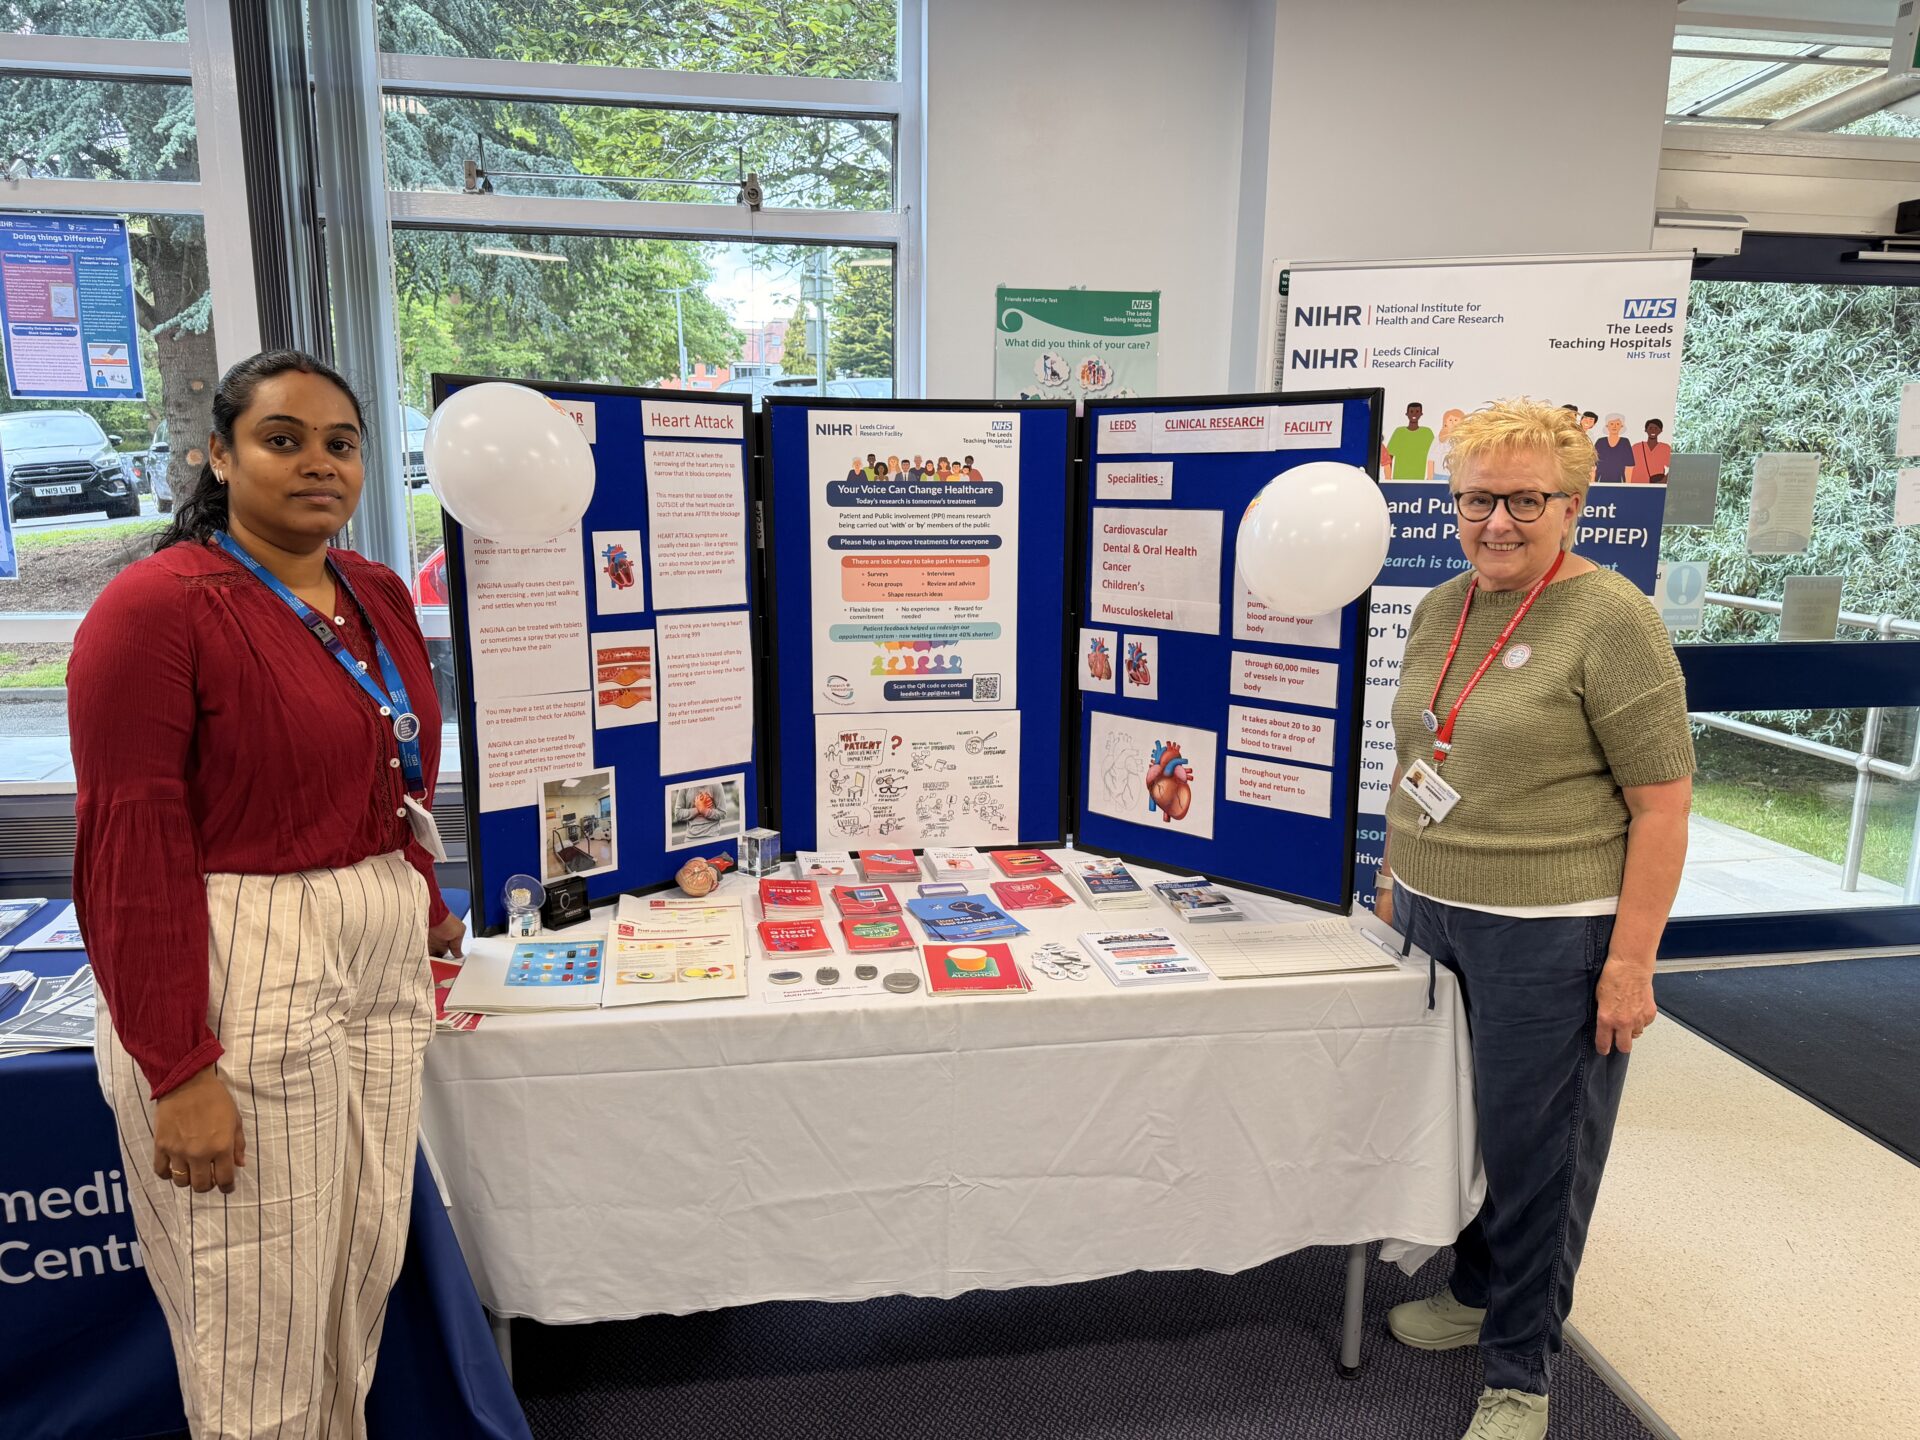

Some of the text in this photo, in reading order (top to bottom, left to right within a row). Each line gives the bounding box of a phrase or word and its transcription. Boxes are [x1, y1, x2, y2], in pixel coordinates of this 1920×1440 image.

[13, 233, 106, 244] Doing things Differently
[1132, 301, 1151, 309] NHS
[1376, 302, 1481, 313] National Institute for
[1626, 300, 1676, 318] NHS
[1295, 305, 1361, 326] NIHR
[1375, 314, 1503, 325] Health and Care Research
[1606, 322, 1672, 334] The Leeds
[1004, 338, 1028, 347] What
[1031, 339, 1045, 347] did
[1093, 340, 1102, 348] of
[1105, 342, 1124, 350] your
[1549, 336, 1671, 351] Teaching Hospitals
[1373, 346, 1438, 356] Leeds Clinical
[1626, 350, 1645, 358] NHS
[1292, 348, 1357, 369] NIHR
[1372, 358, 1453, 369] Research Facility
[652, 412, 733, 428] Heart Attack
[1165, 416, 1264, 431] CLINICAL RESEARCH
[816, 424, 851, 435] NIHR
[992, 422, 1012, 430] NHS
[1109, 420, 1136, 432] LEEDS
[1284, 421, 1332, 434] FACILITY
[1108, 474, 1158, 485] Specialities
[60, 486, 77, 494] LHD
[838, 485, 992, 495] Your Voice Can Change Healthcare
[1388, 498, 1422, 514] and
[1103, 524, 1167, 535] Cardiovascular
[1401, 523, 1437, 539] and
[1574, 526, 1648, 548] (PPIEP)
[1103, 543, 1196, 556] Dental & Oral Health
[1102, 561, 1130, 571] Cancer
[1384, 555, 1442, 568] earch is
[475, 578, 574, 591] ANGINA usually causes chest pain
[1102, 604, 1172, 620] Musculoskeletal
[1371, 603, 1412, 614] eans
[1268, 614, 1295, 623] around
[1246, 624, 1264, 633] body
[1368, 627, 1387, 638] or
[1245, 659, 1319, 674] through 60,000 miles
[1370, 657, 1384, 667] of
[1253, 672, 1277, 681] vessels
[1244, 683, 1261, 692] body
[1248, 715, 1267, 724] takes
[1269, 718, 1289, 727] about
[1312, 724, 1320, 732] 30
[1376, 720, 1390, 729] or
[1241, 726, 1268, 736] seconds
[1270, 730, 1280, 738] for
[1288, 733, 1305, 743] drop
[844, 741, 882, 751] PATIENT
[1241, 737, 1261, 747] blood
[1271, 743, 1291, 752] travel
[1242, 767, 1298, 782] throughout your
[1239, 778, 1257, 788] body
[1273, 784, 1295, 793] return
[1252, 792, 1270, 800] heart
[0, 1234, 144, 1284] Centr
